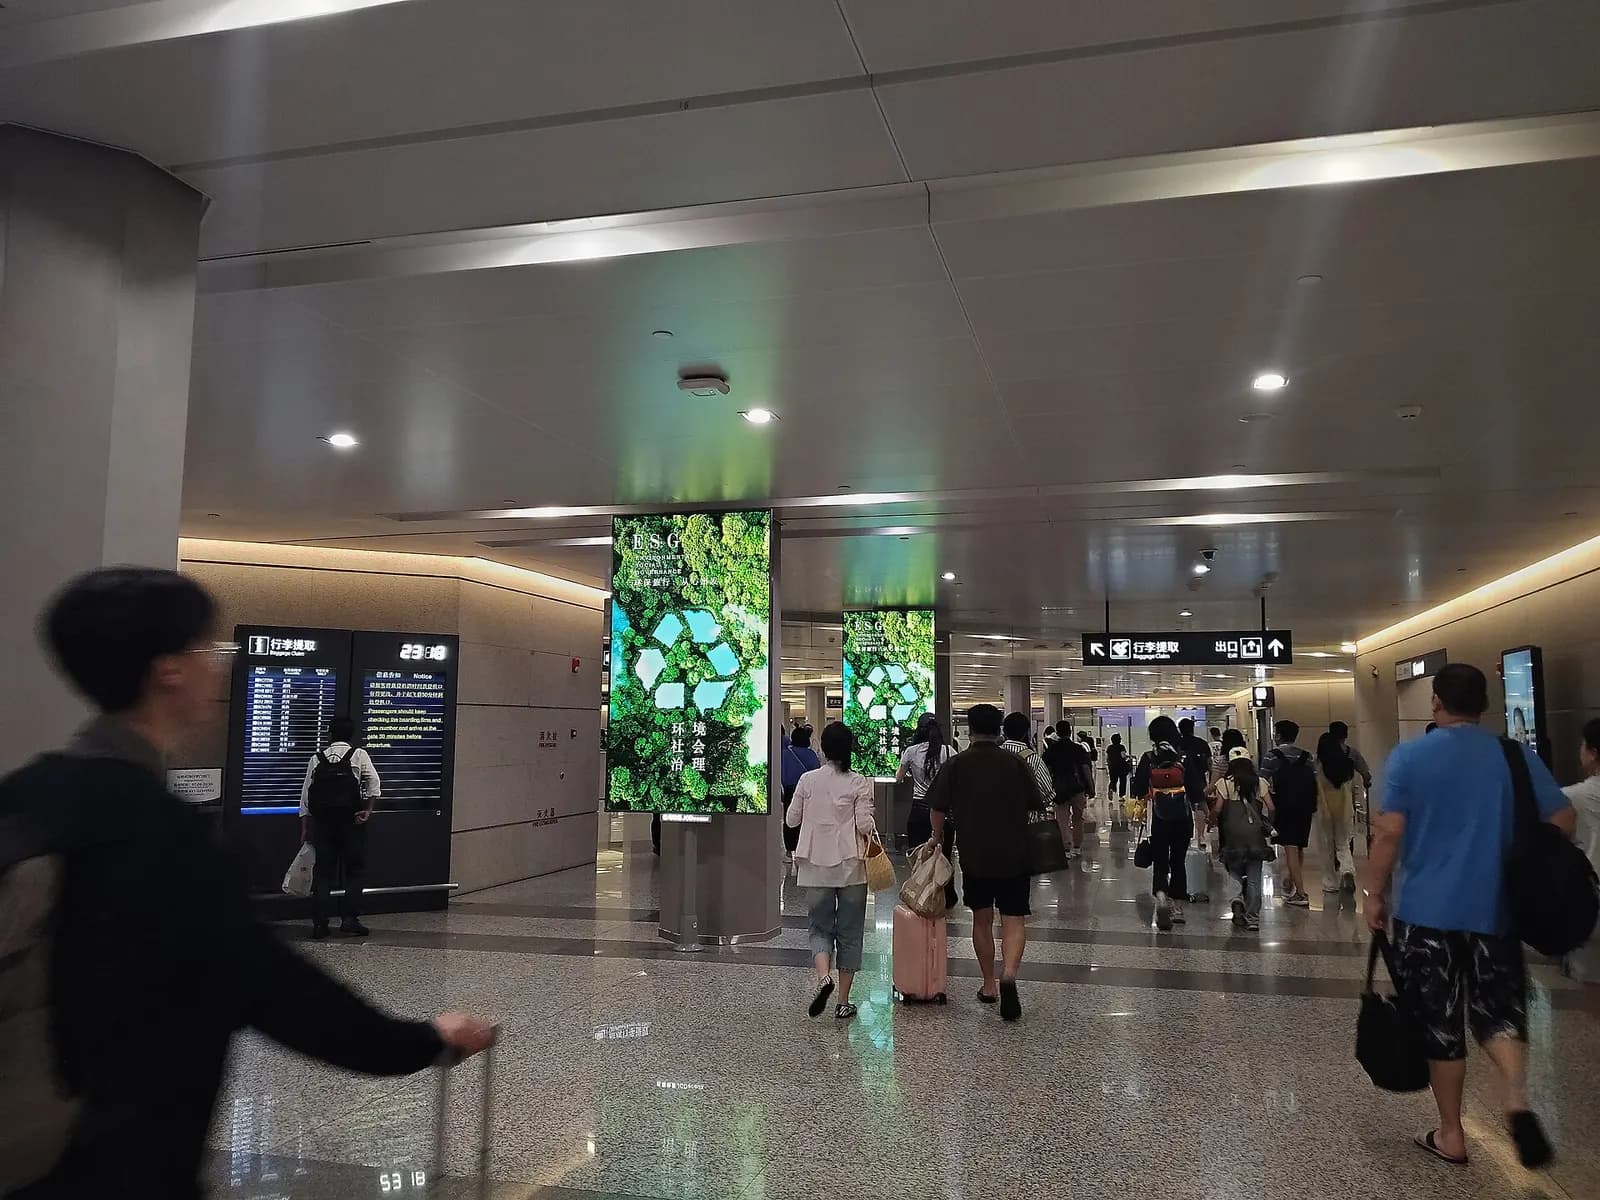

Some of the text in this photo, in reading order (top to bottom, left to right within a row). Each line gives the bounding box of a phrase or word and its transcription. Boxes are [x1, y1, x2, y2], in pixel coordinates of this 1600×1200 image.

[270, 638, 317, 652] 行李提取
[1133, 641, 1179, 653] 行李提取
[1215, 641, 1238, 652] 出口
[413, 672, 433, 680] Notice
